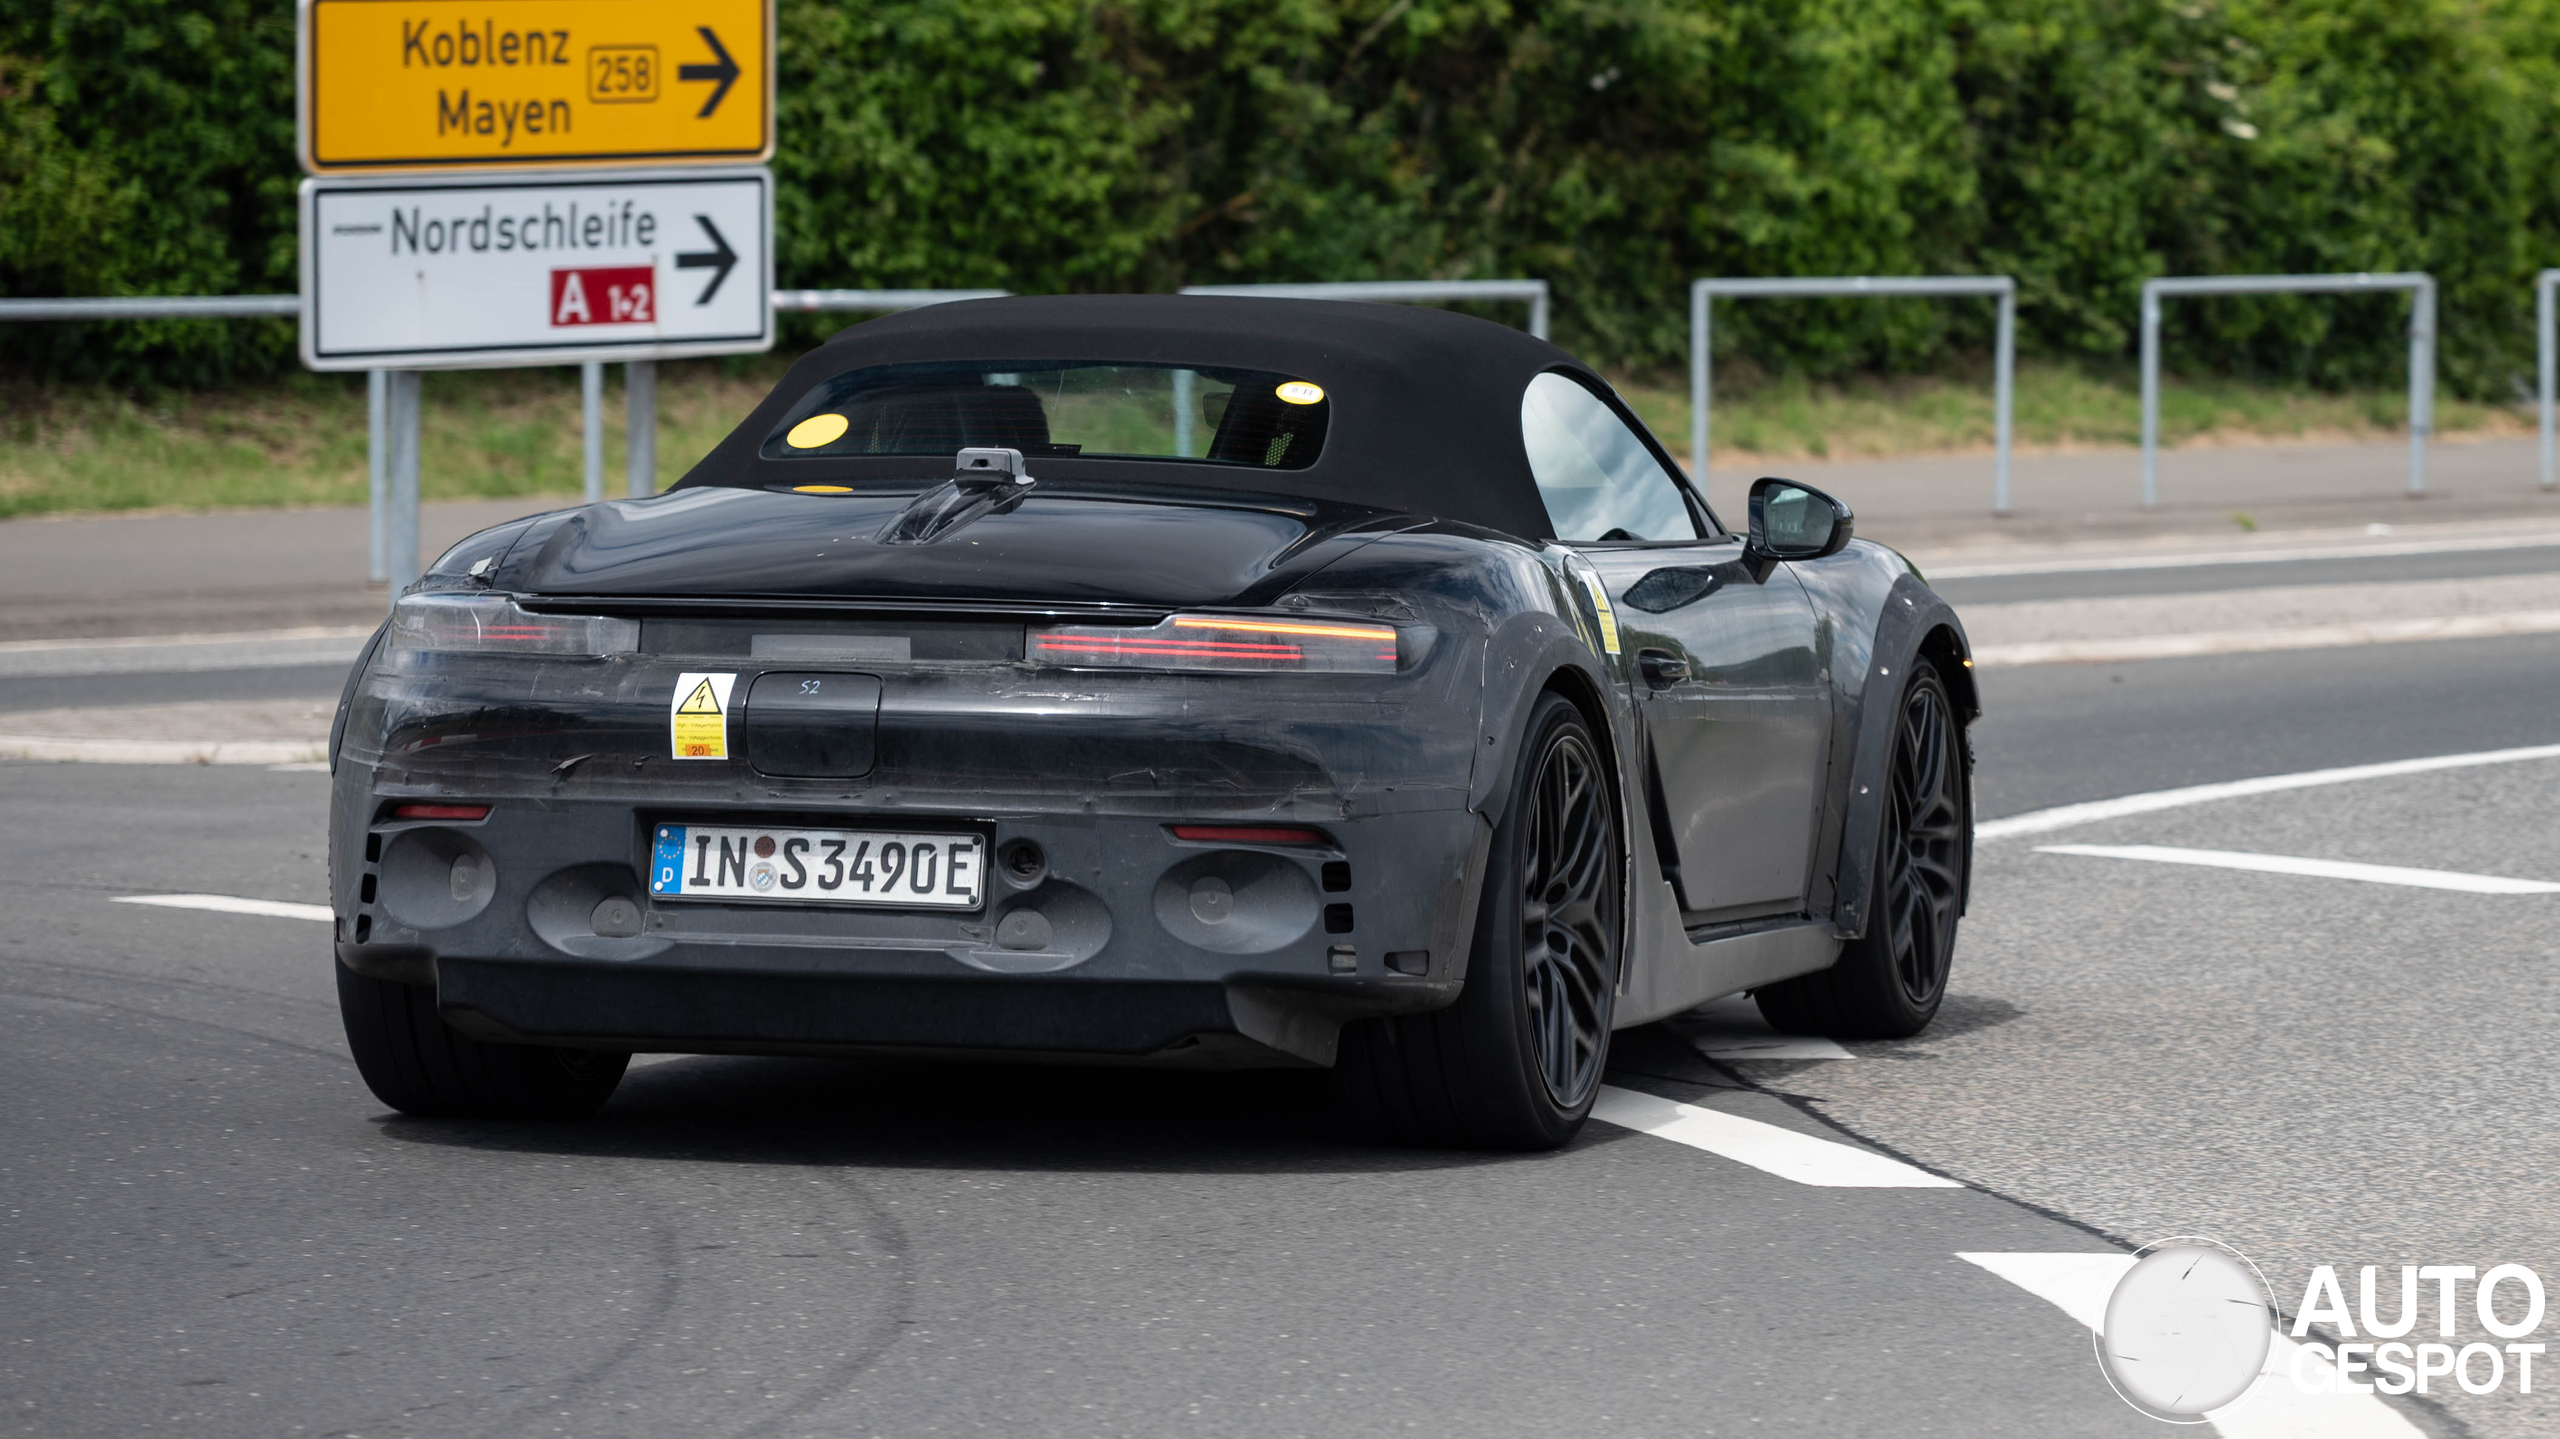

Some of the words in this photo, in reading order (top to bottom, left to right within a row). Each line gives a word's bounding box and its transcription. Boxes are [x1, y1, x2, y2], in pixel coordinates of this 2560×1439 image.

[403, 19, 571, 68] Koblenz
[595, 56, 651, 93] 258
[437, 89, 572, 147] Mayen
[391, 200, 657, 255] Nordschleife
[556, 270, 591, 324] A
[691, 745, 705, 756] 20
[661, 867, 673, 883] D
[689, 836, 748, 888] IN
